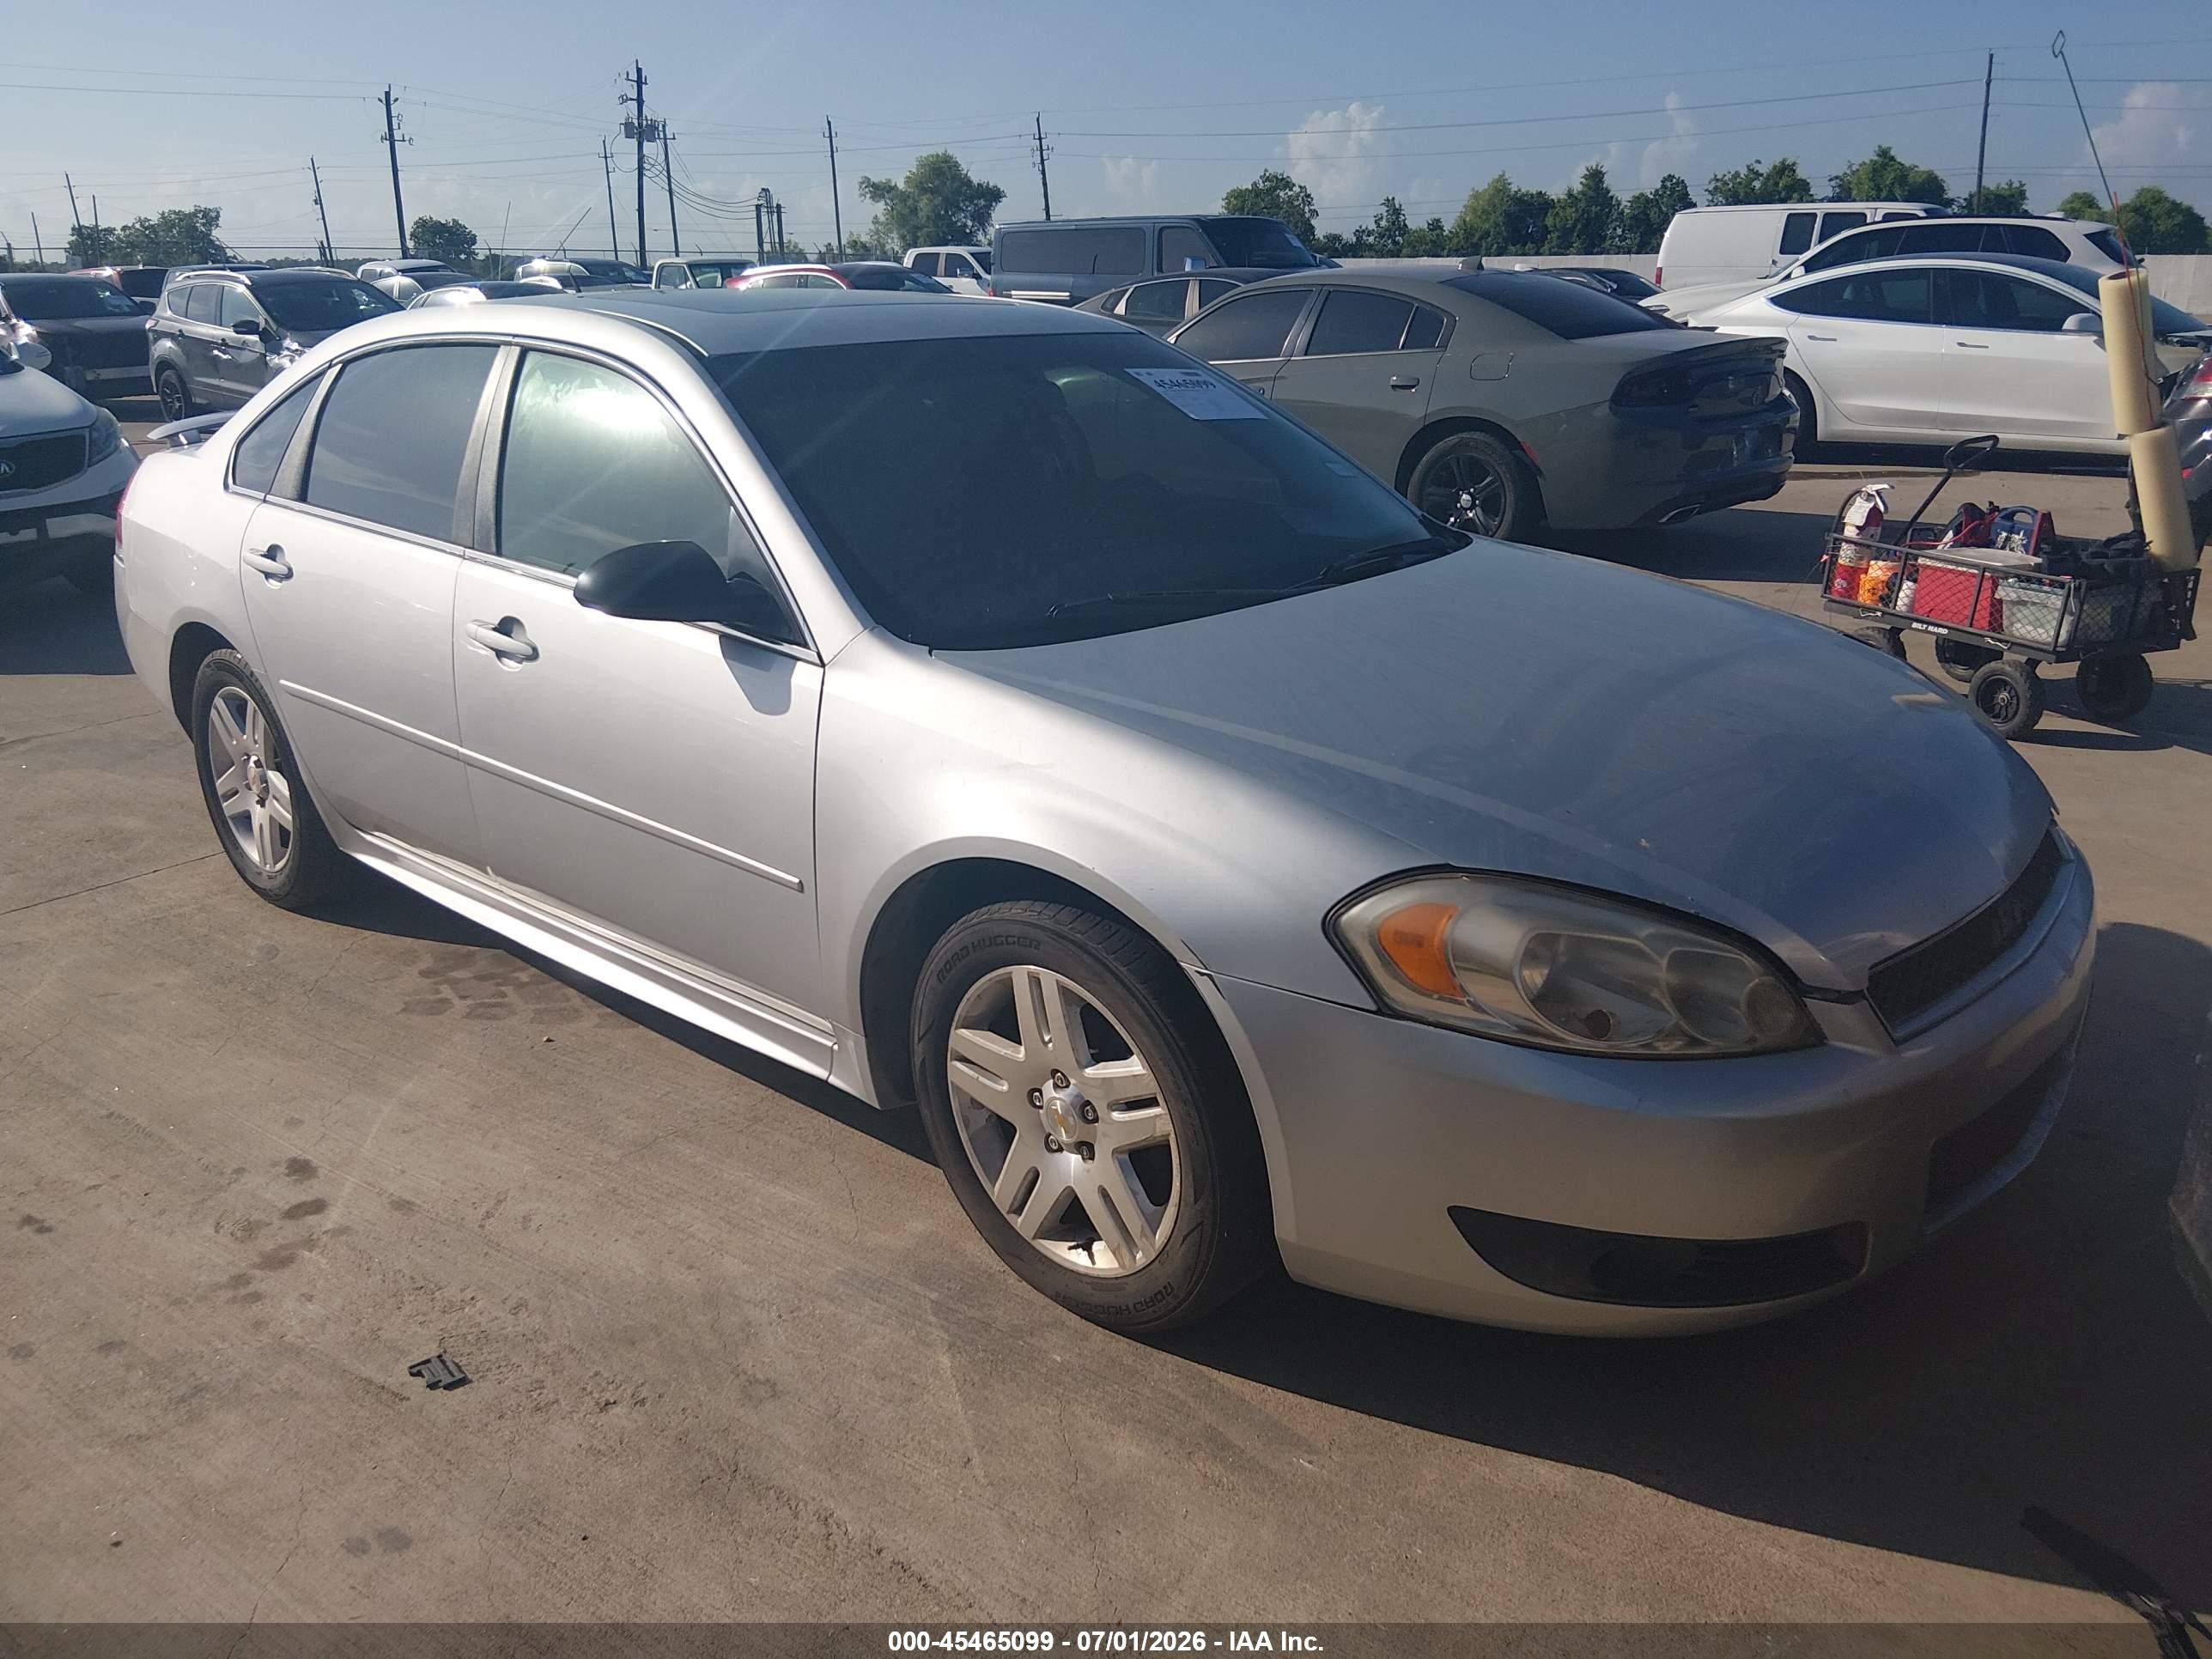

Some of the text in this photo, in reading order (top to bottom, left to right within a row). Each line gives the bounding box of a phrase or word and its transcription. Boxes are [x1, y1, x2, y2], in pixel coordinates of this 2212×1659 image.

[1911, 622, 1948, 635] BILT HARD
[936, 934, 1042, 983] ROAD HUGGER
[1133, 1280, 1176, 1314] ROAD
